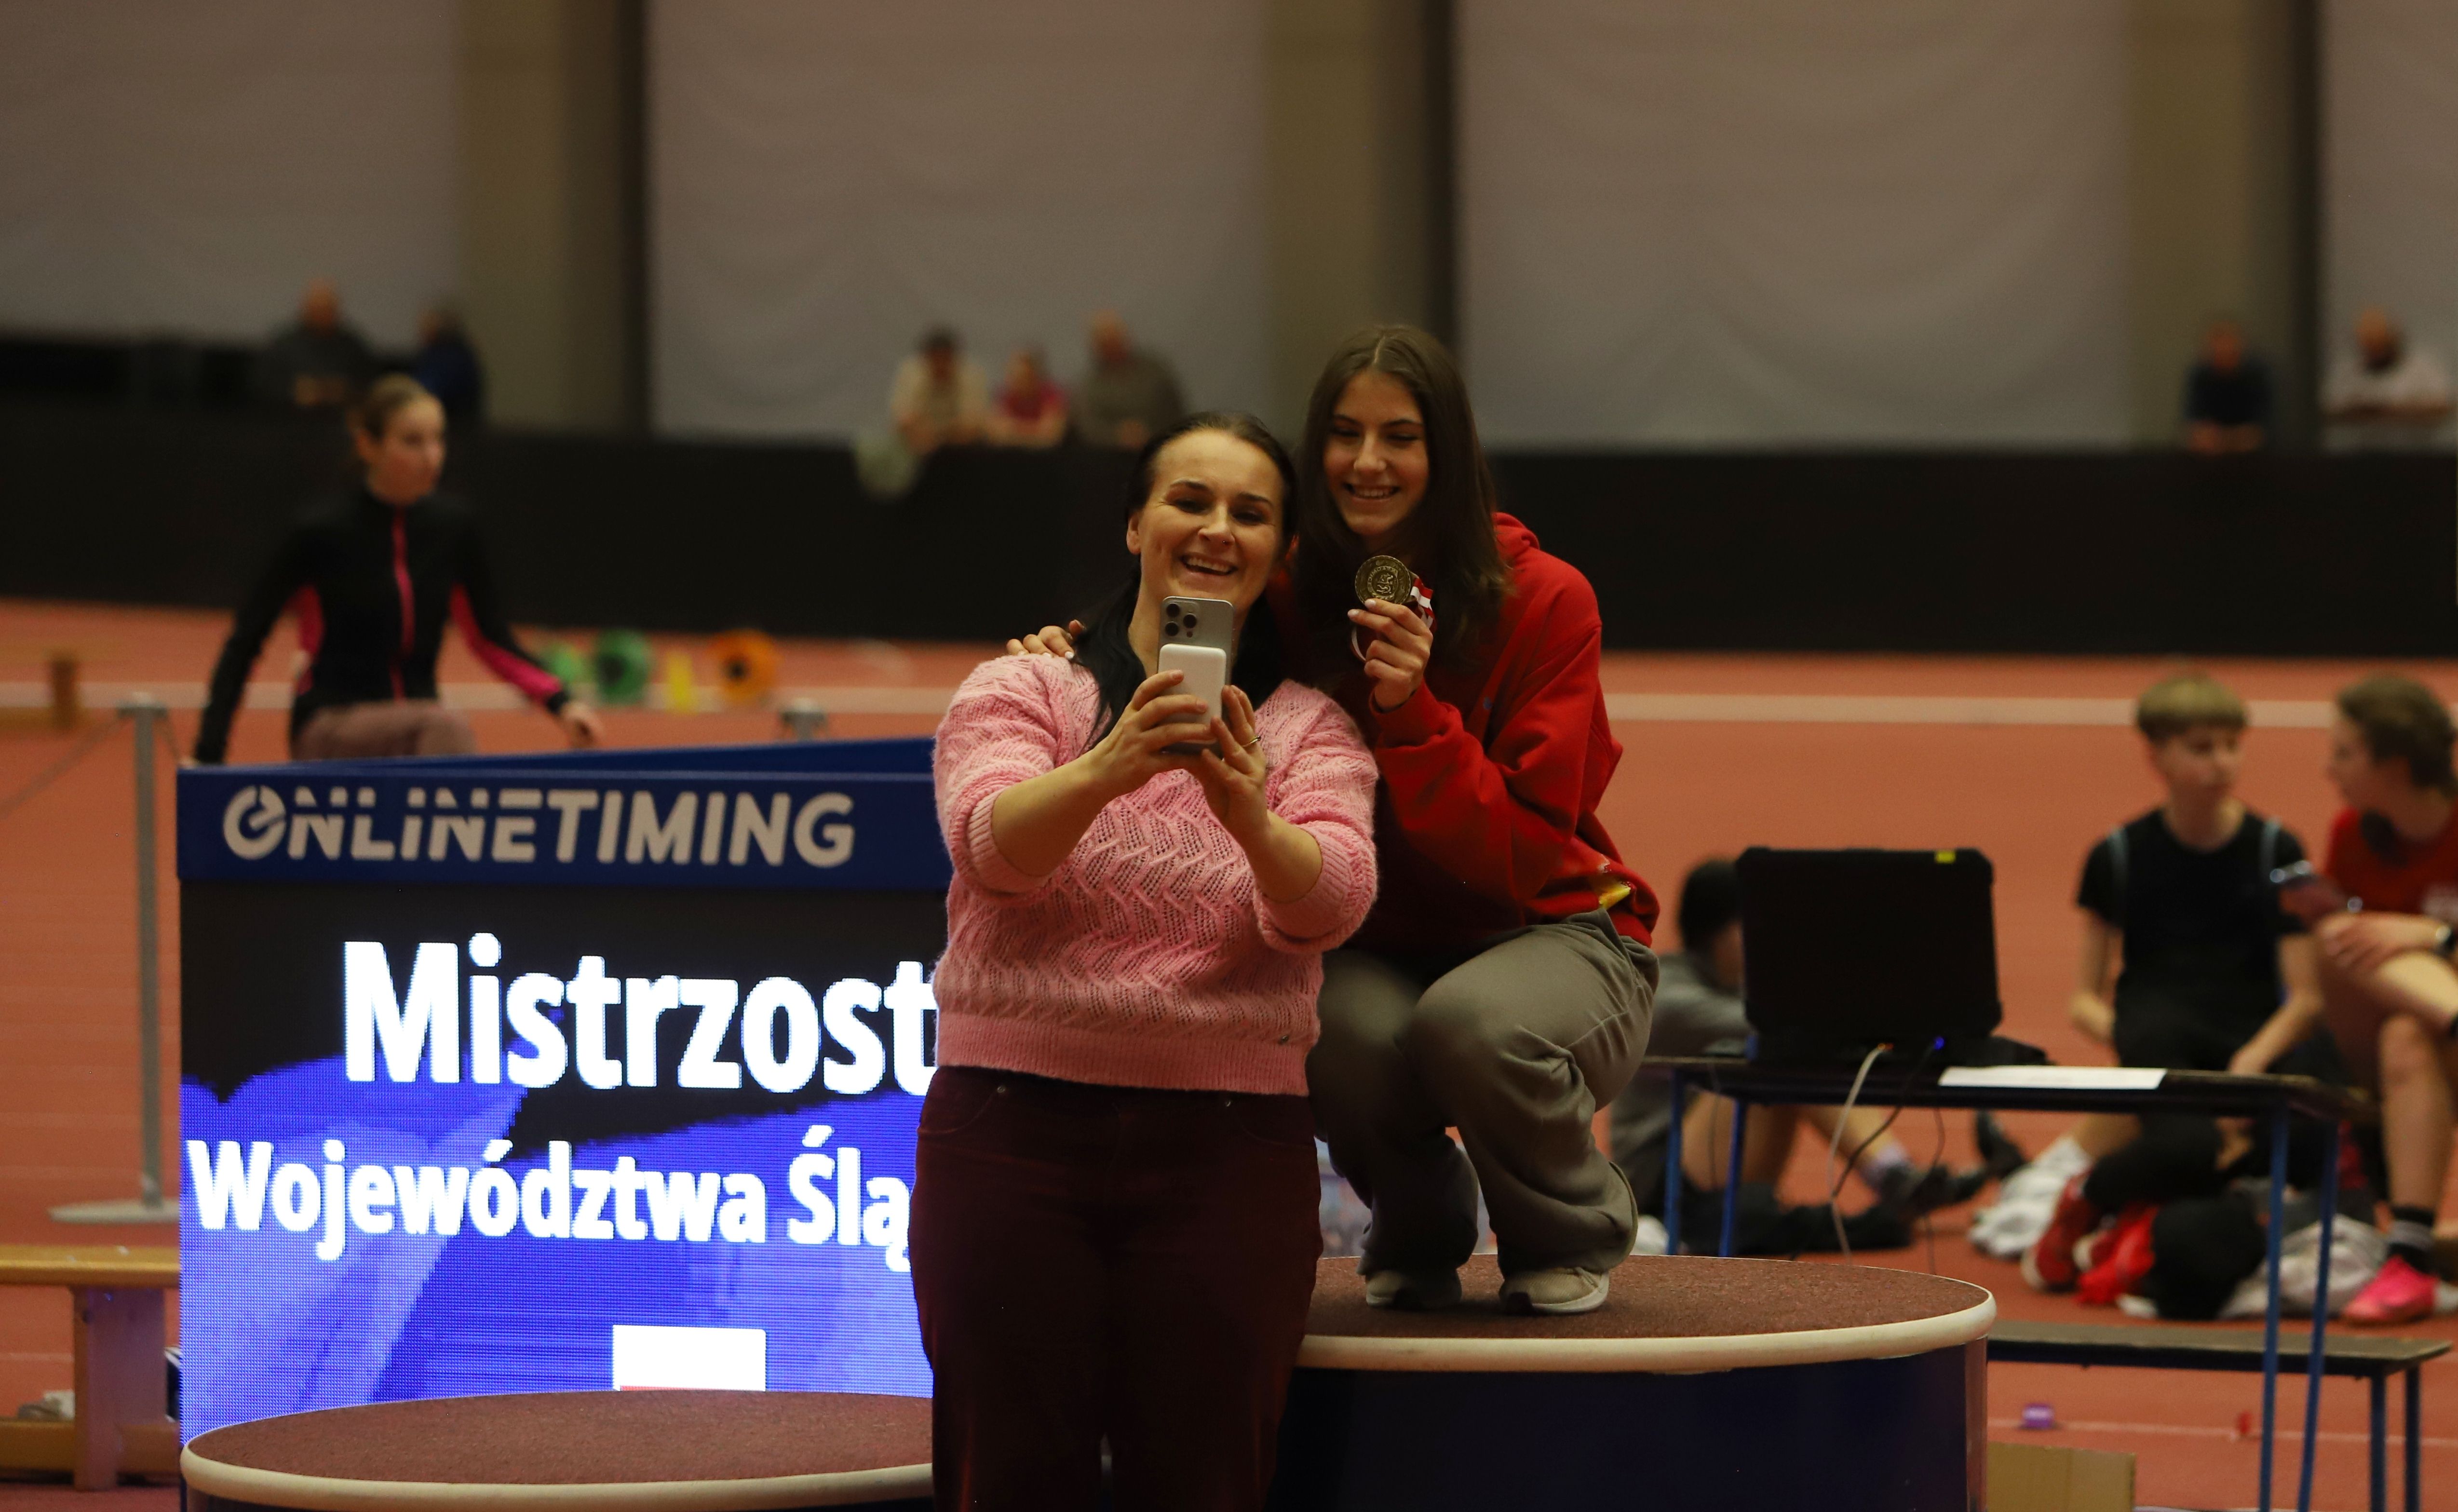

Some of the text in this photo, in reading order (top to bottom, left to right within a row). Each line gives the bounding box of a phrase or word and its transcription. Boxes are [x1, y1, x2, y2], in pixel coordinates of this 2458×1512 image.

[343, 933, 939, 1096] Mistrzost
[186, 1124, 911, 1272] Województwa Ślą
